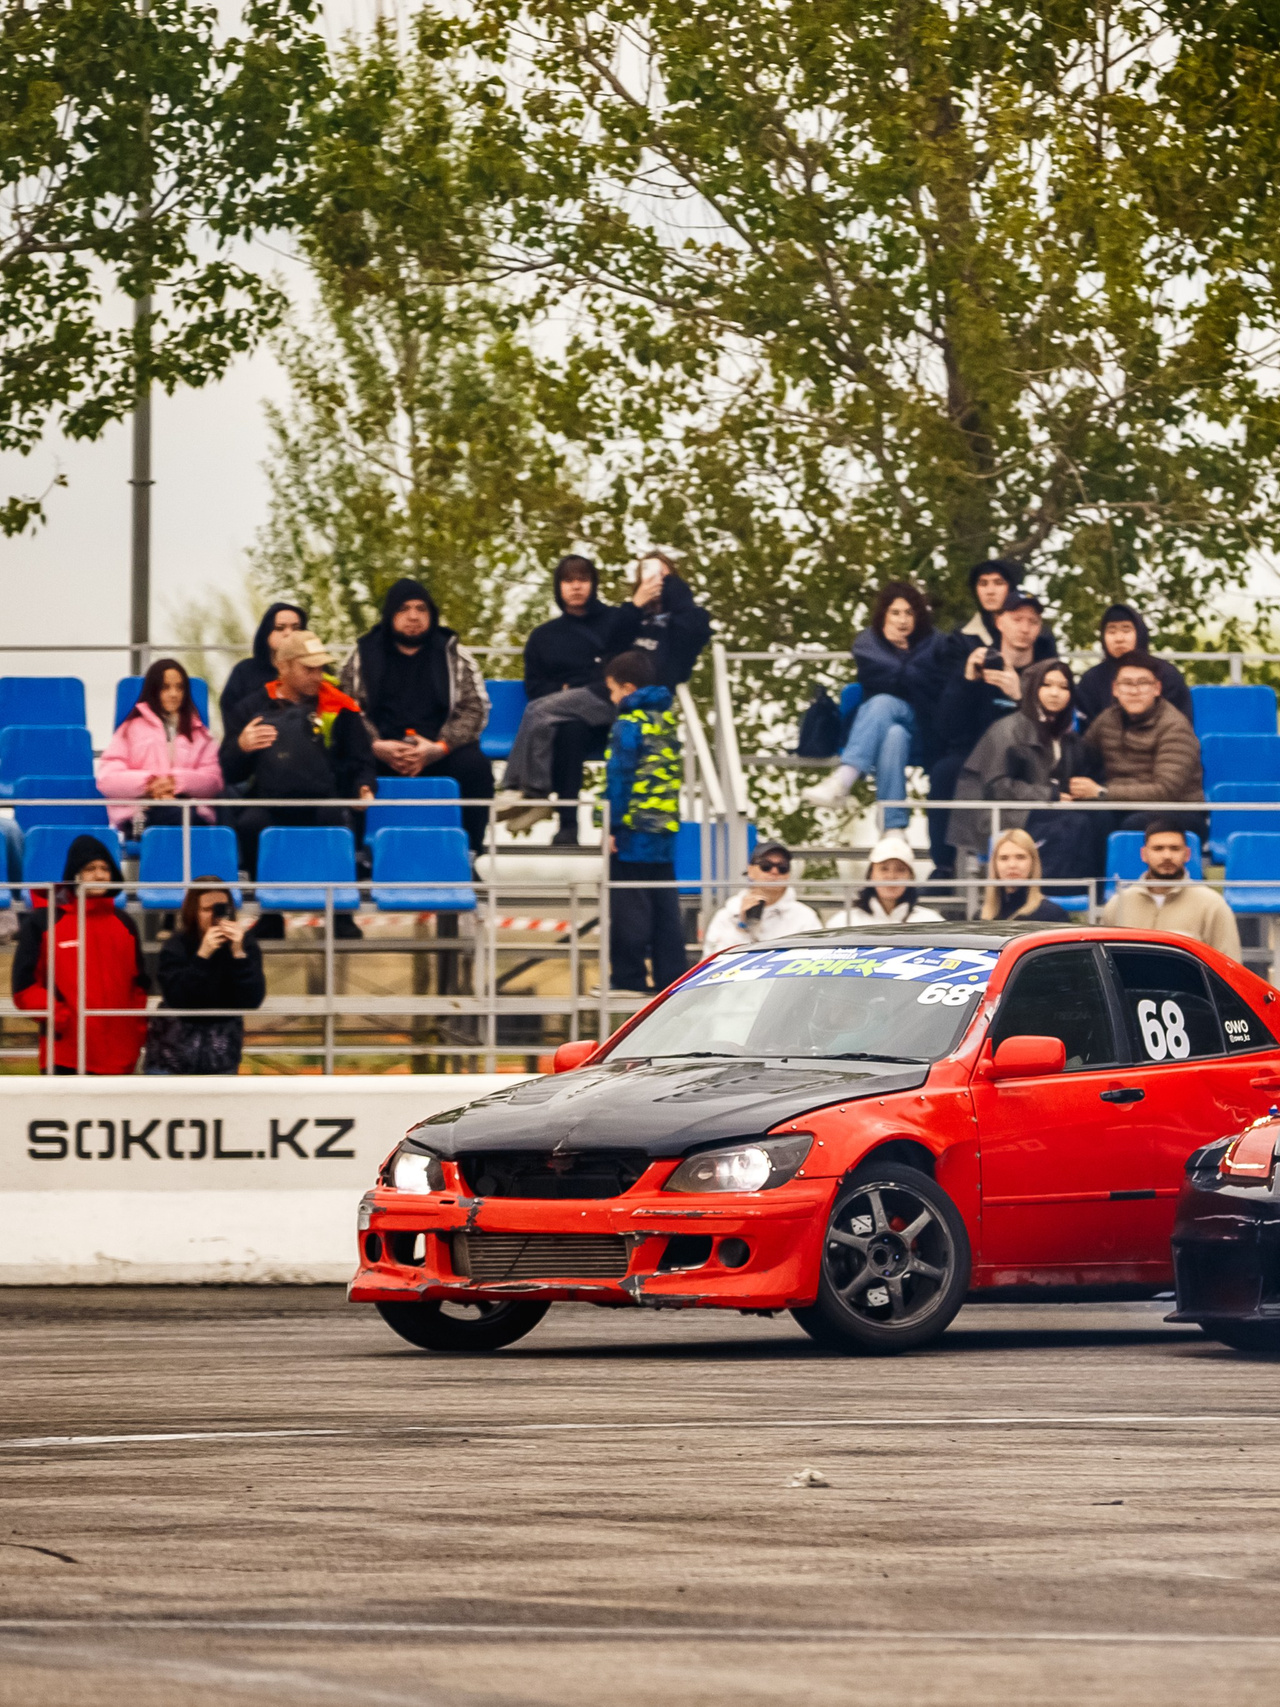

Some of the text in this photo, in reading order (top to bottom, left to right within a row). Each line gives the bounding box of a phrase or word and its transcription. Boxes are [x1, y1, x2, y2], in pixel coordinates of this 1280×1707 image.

[775, 959, 883, 977] DRIFT
[917, 982, 974, 1006] 68
[1137, 999, 1191, 1061] 68
[1224, 1019, 1249, 1034] OWO
[27, 1118, 356, 1159] SOKOL.KZ
